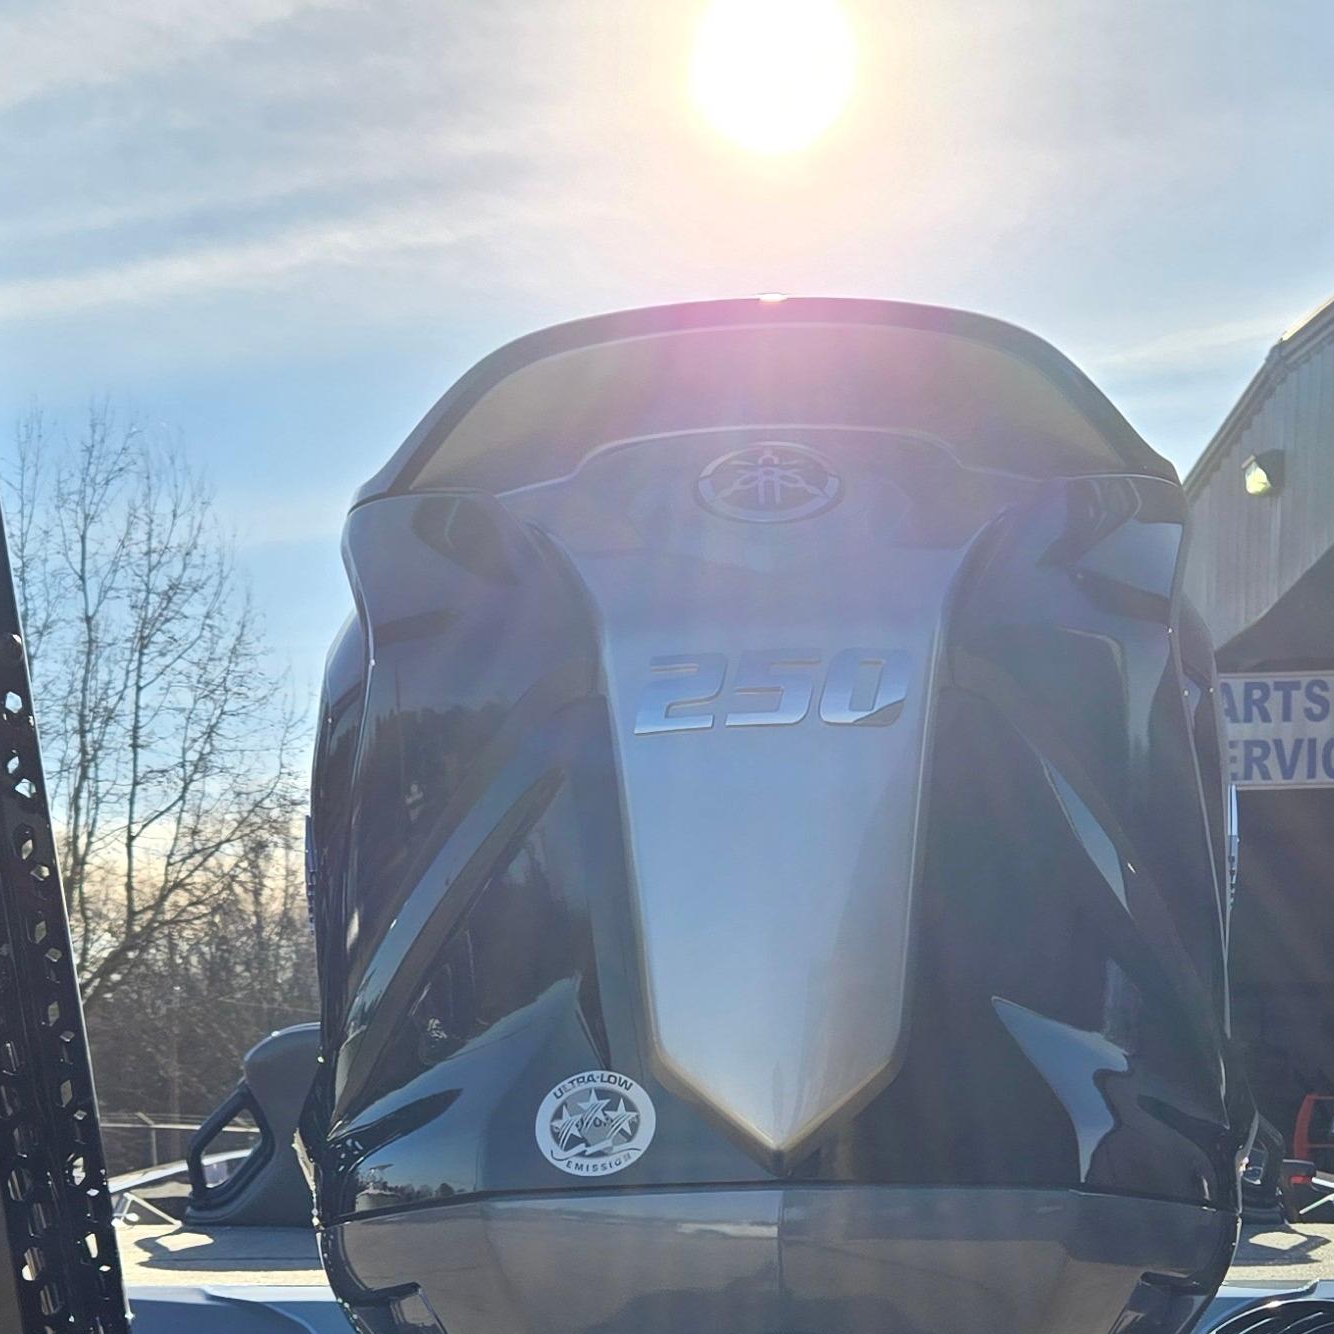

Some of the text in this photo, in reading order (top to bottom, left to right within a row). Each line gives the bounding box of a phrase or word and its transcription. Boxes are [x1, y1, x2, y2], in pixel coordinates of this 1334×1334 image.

[634, 647, 913, 736] 250
[1219, 679, 1330, 724] ARTS
[566, 1152, 632, 1173] EMISSION
